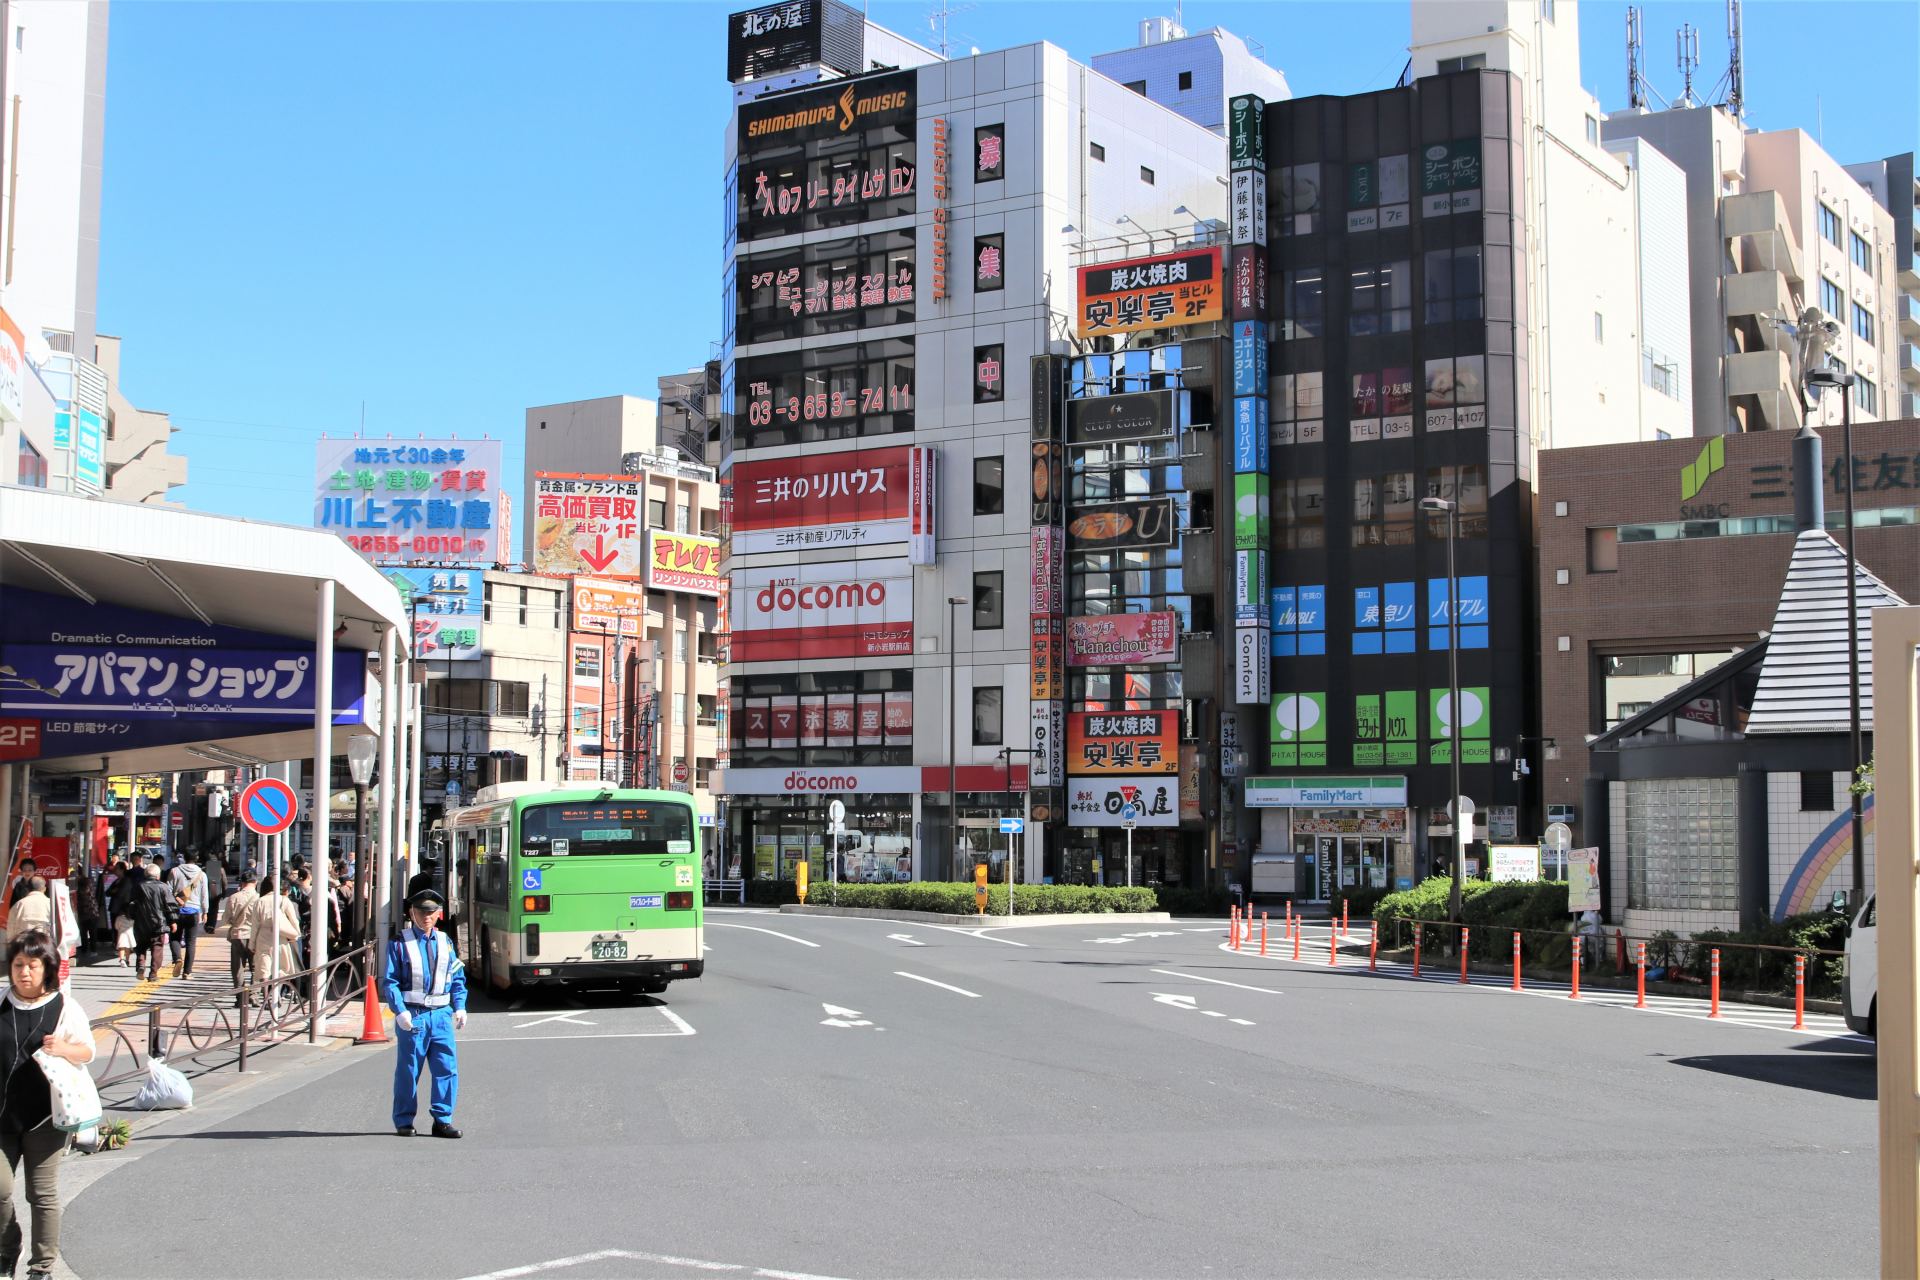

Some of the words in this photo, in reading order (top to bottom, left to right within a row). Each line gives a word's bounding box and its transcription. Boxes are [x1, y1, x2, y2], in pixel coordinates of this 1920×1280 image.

[1236, 176, 1249, 240] 伊藤葬祭
[1385, 210, 1404, 223] 7F
[1110, 260, 1188, 291] 炭火焼肉
[1241, 256, 1250, 308] たかの友梨
[1179, 283, 1214, 299] 当ビル
[1085, 291, 1176, 331] 安楽亭
[1185, 300, 1208, 317] 2F
[1244, 338, 1253, 369] エース
[750, 381, 772, 396] TEL
[1239, 400, 1251, 469] 東急リバブル
[1303, 427, 1317, 438] 5F
[755, 467, 887, 504] 三井のリハウス
[320, 497, 492, 530] 川上不動産
[538, 494, 637, 521] 高価買取
[1679, 503, 1730, 519] SMBC
[615, 523, 636, 539] 1F
[1136, 504, 1168, 539] U
[775, 527, 868, 546] 三井不動産リアルティ
[655, 573, 716, 590] リンリンハウス
[777, 577, 796, 587] NTT
[1239, 556, 1247, 599] FamilyMart
[756, 579, 886, 613] docomo
[51, 632, 113, 645] Dramatic
[115, 633, 217, 647] Communication
[863, 629, 911, 641] ドコモショップ
[1073, 635, 1148, 655] Hanachou
[53, 650, 311, 701] アパマンショップ
[1242, 634, 1253, 697] Comfort
[46, 722, 71, 733] LED
[73, 722, 131, 735] 節電サイン
[749, 709, 880, 731] スマホ教室
[1088, 716, 1156, 736] 炭火焼肉
[0, 726, 37, 746] 2F
[1083, 741, 1163, 768] 安楽亭
[1271, 751, 1297, 759] PITAT
[1300, 751, 1326, 759] HOUSE
[1462, 748, 1490, 756] HOUSE
[1165, 762, 1177, 771] 2F
[784, 771, 858, 791] docomo
[1300, 789, 1363, 804] FamilyMart
[1071, 801, 1101, 813] 中華食堂
[1319, 838, 1332, 899] FamilyMart
[598, 946, 627, 958] 20-82
